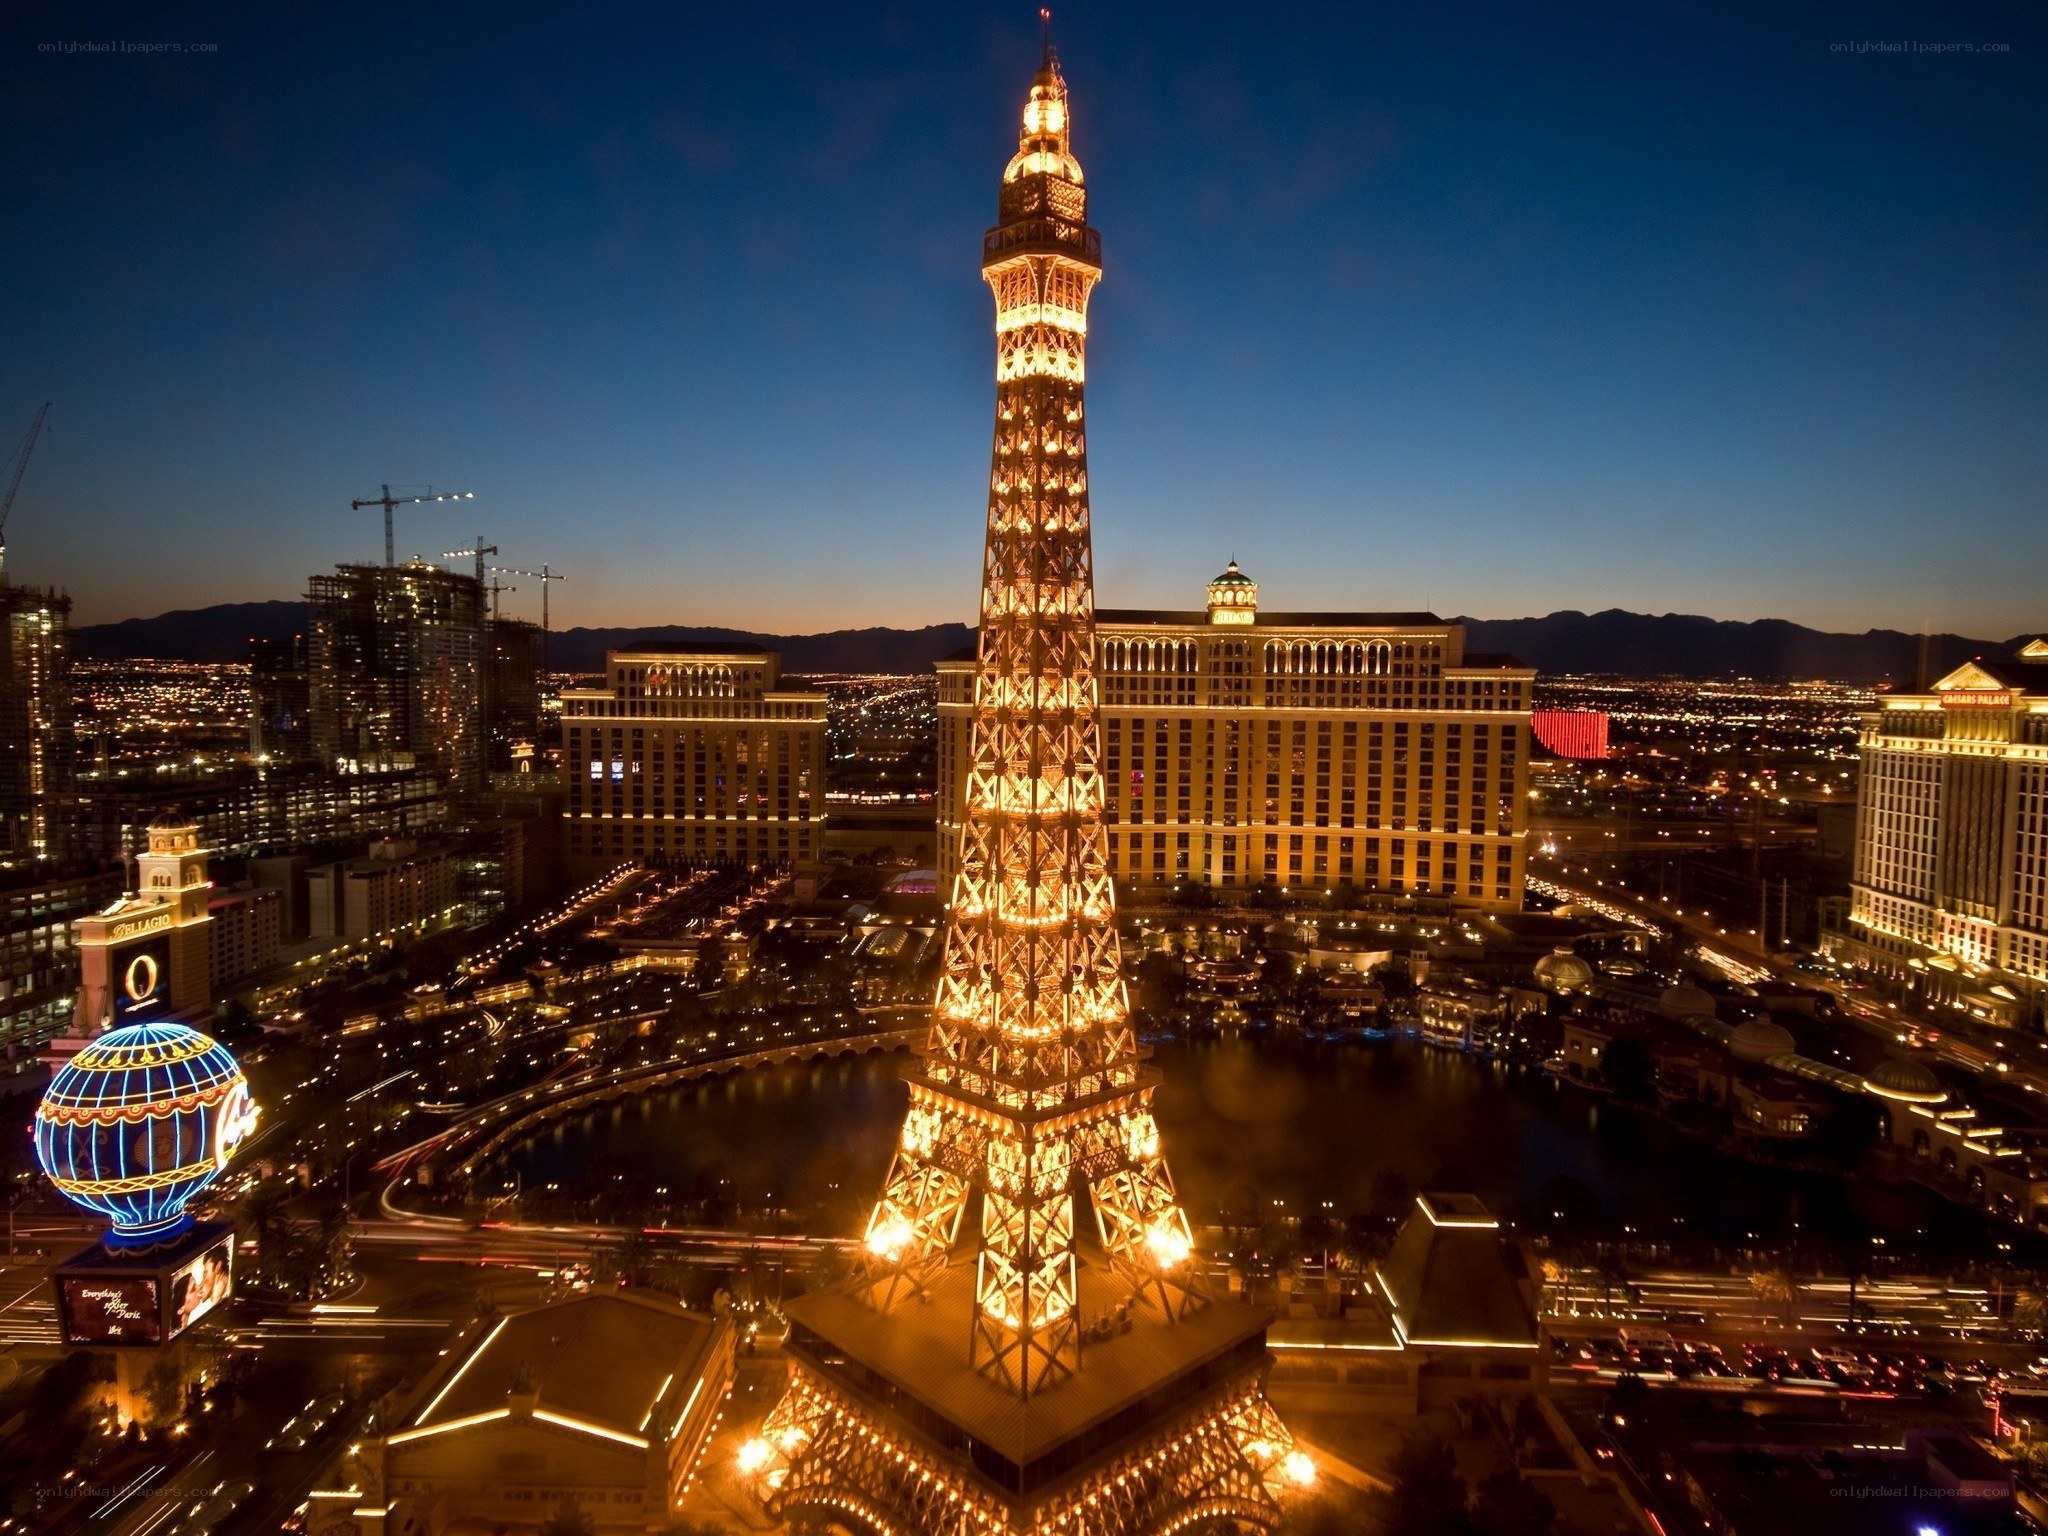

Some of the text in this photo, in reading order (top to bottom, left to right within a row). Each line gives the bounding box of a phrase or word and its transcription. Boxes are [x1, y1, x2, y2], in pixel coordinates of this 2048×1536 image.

[1977, 694, 2010, 706] PALACE
[110, 914, 170, 940] BELLAGIO
[125, 955, 157, 1001] O
